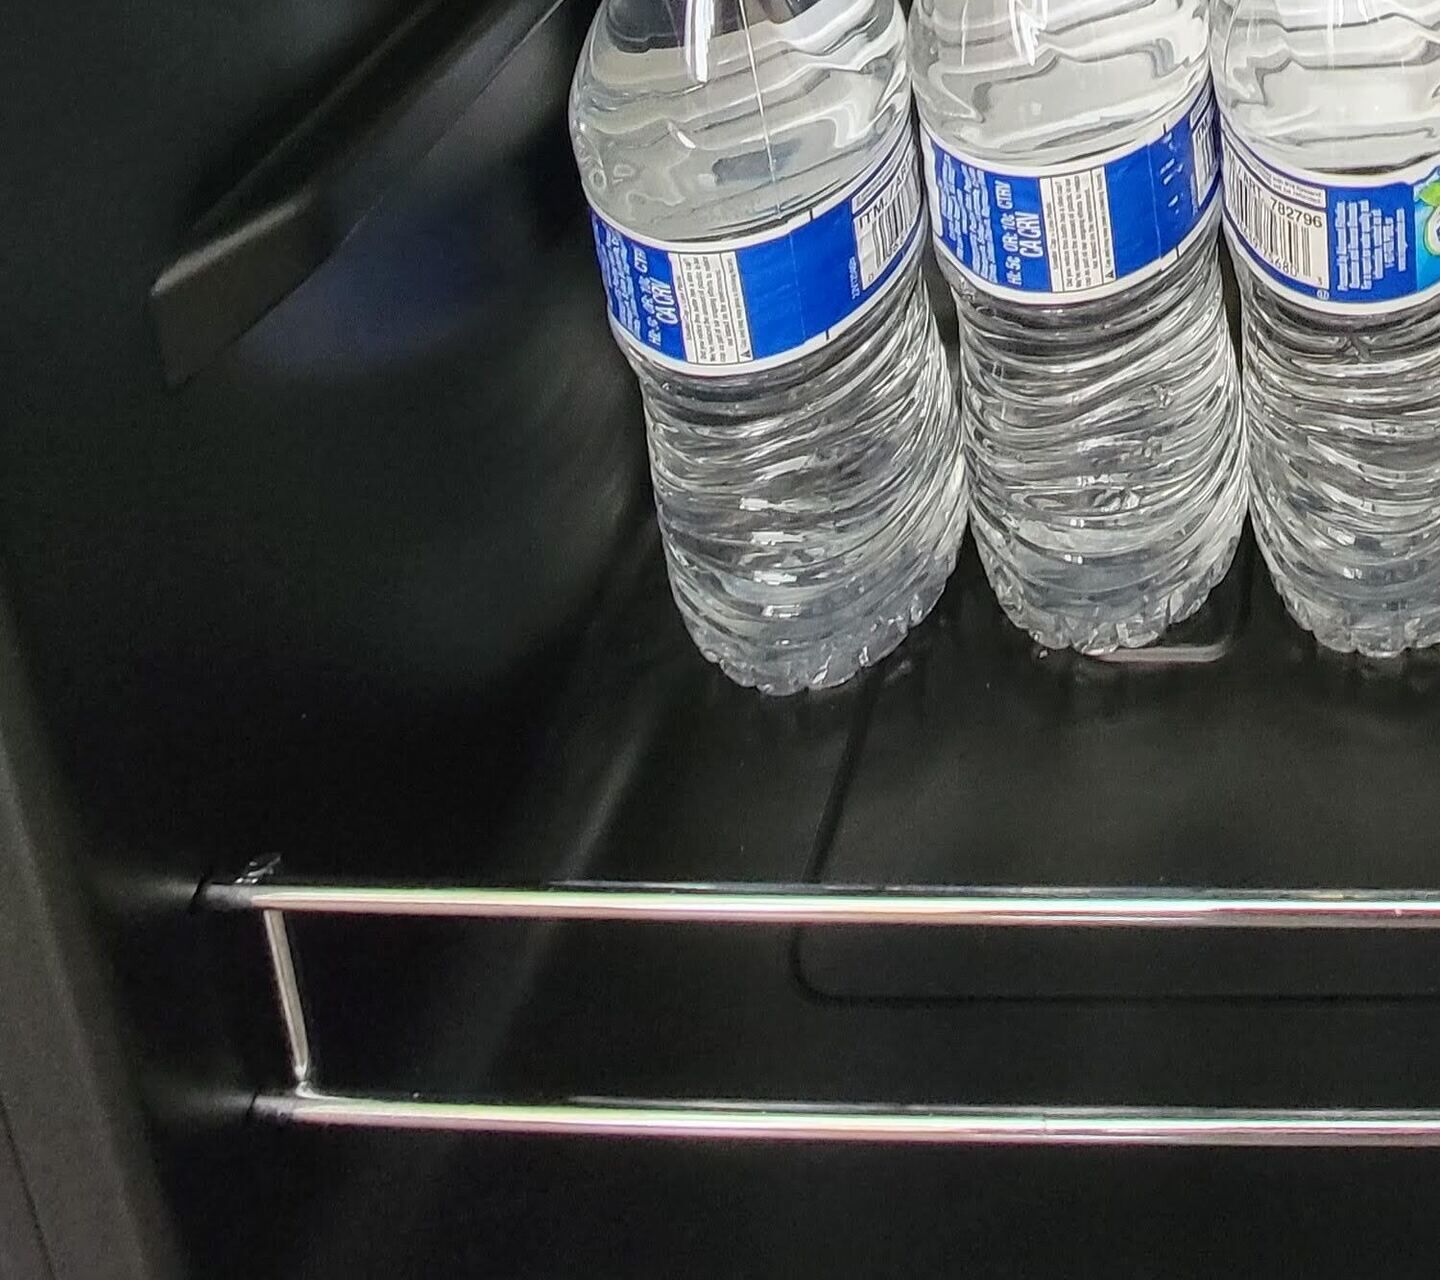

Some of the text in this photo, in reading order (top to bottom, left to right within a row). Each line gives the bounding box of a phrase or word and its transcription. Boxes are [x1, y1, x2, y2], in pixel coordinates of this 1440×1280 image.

[1270, 196, 1323, 228] 782796
[1014, 211, 1044, 258] CA CRV
[656, 304, 679, 325] CA
